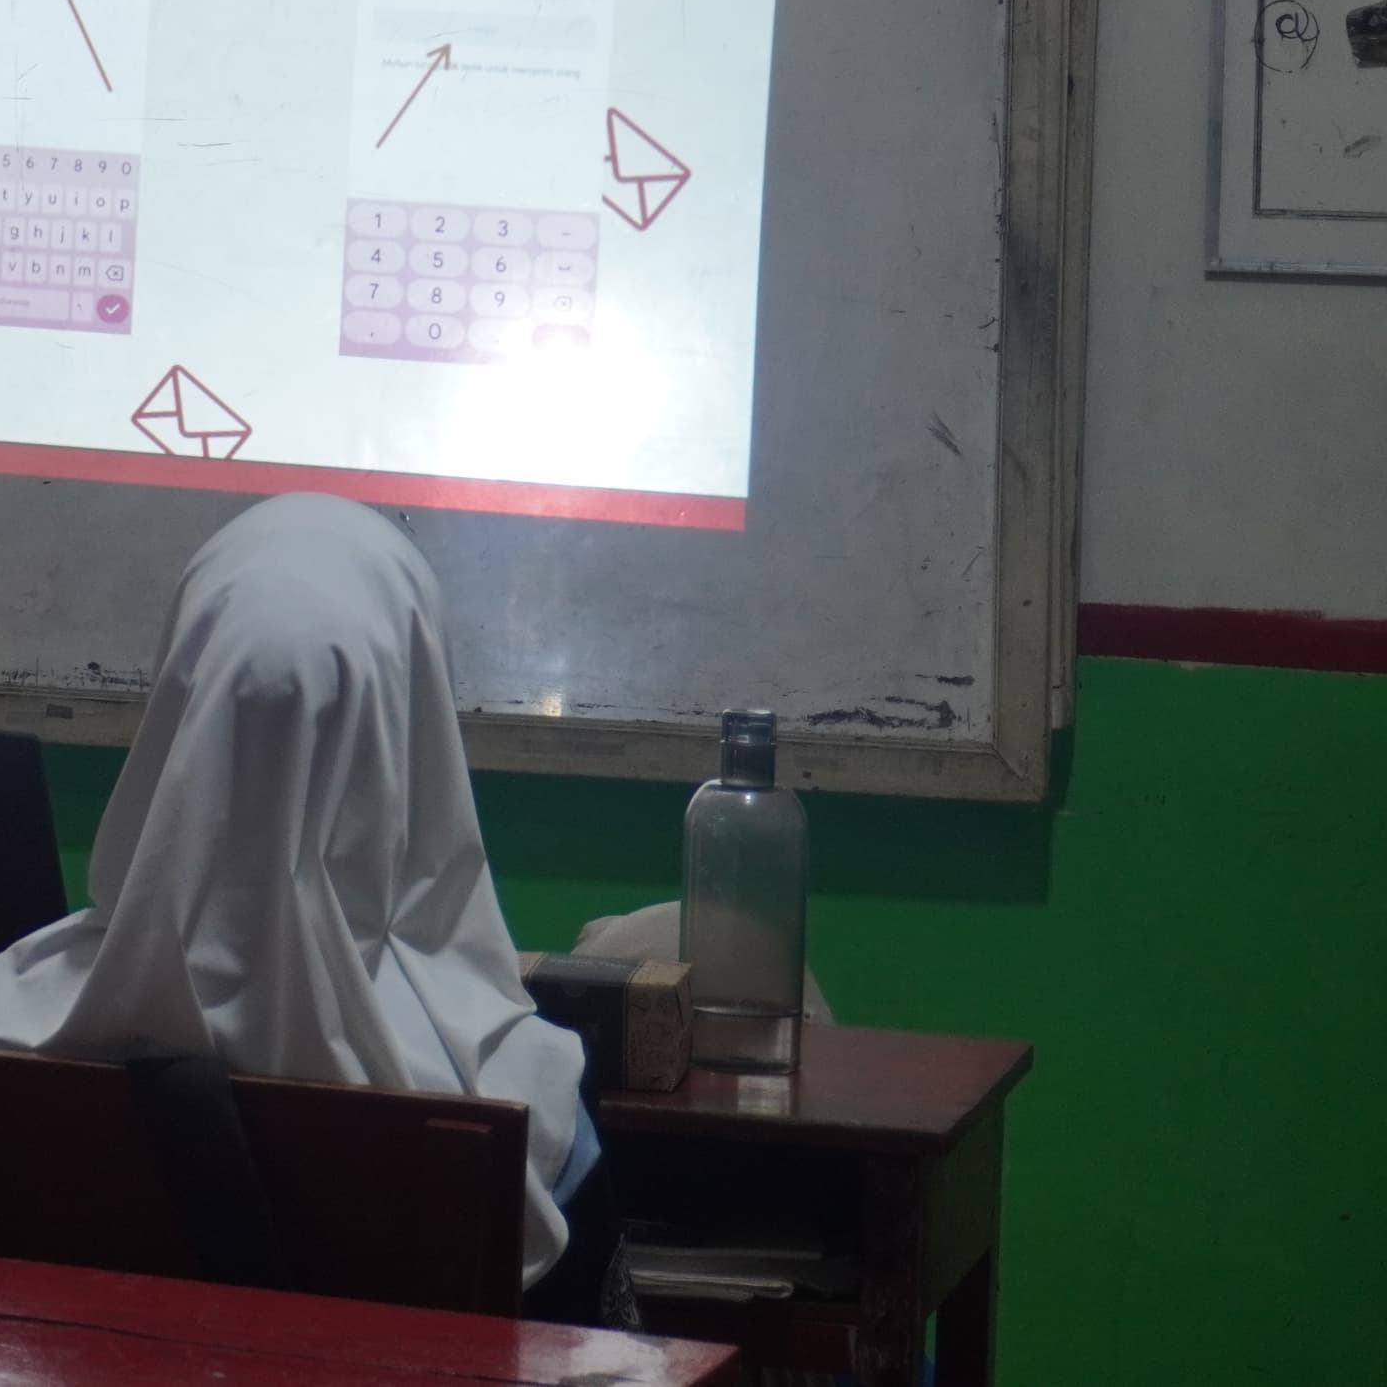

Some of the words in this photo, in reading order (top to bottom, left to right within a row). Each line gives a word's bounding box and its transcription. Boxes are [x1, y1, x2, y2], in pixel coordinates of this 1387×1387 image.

[3, 154, 11, 167] 5
[26, 156, 35, 170] 6
[51, 157, 59, 170] 7
[74, 158, 83, 173] 8
[98, 160, 107, 174] 9
[121, 161, 132, 175] 0
[2, 189, 8, 201] t
[24, 192, 33, 206] y
[48, 193, 57, 205] u
[96, 197, 106, 208] o
[120, 197, 131, 212] p
[10, 225, 20, 240] g
[33, 225, 43, 239] h
[59, 226, 65, 244] j
[82, 226, 90, 241] k
[374, 212, 382, 229] 1
[434, 215, 446, 234] 2
[497, 220, 509, 238] 3
[8, 261, 17, 272] v
[31, 260, 41, 275] b
[56, 264, 65, 276] n
[78, 265, 92, 277] m
[370, 247, 382, 265] 4
[433, 251, 444, 269] 5
[494, 255, 507, 273] 6
[369, 283, 380, 300] 7
[430, 287, 442, 305] 8
[493, 290, 506, 308] 9
[427, 322, 441, 341] 0
